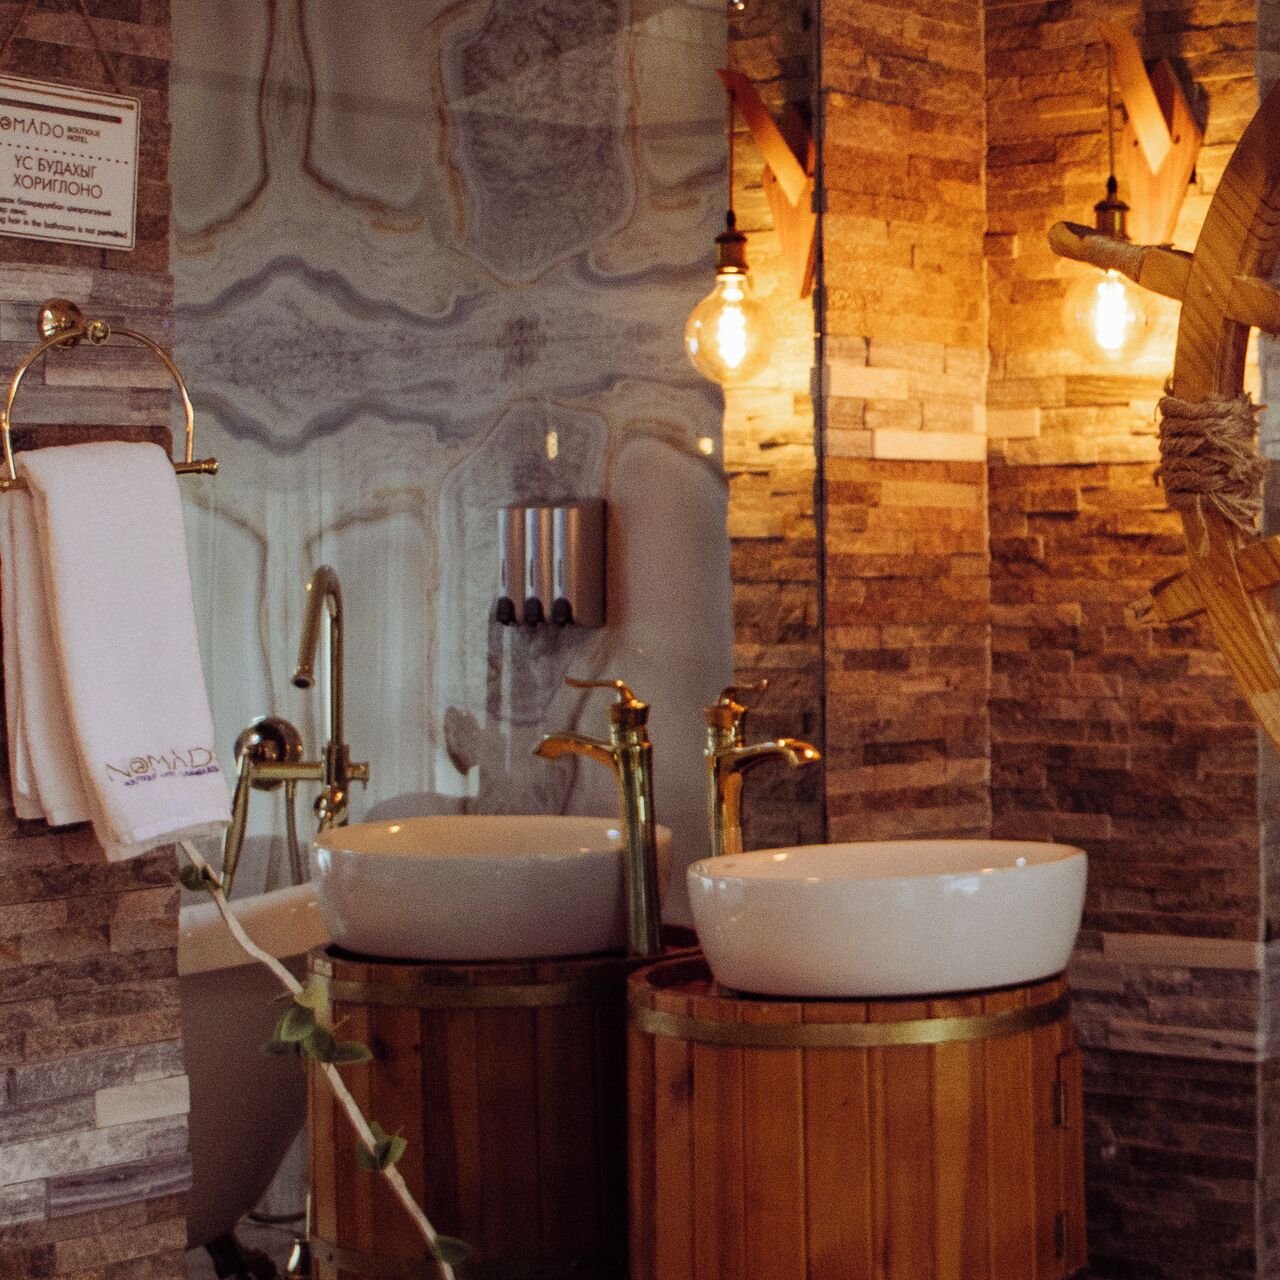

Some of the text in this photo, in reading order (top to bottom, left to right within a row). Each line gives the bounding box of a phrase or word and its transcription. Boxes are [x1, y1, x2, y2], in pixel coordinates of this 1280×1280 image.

[67, 126, 101, 137] BOUTIQUE
[67, 135, 88, 144] HOTEL
[38, 158, 97, 179] БУДАХЫГ
[14, 173, 102, 199] ХОРИГЛОНО
[32, 219, 41, 227] the
